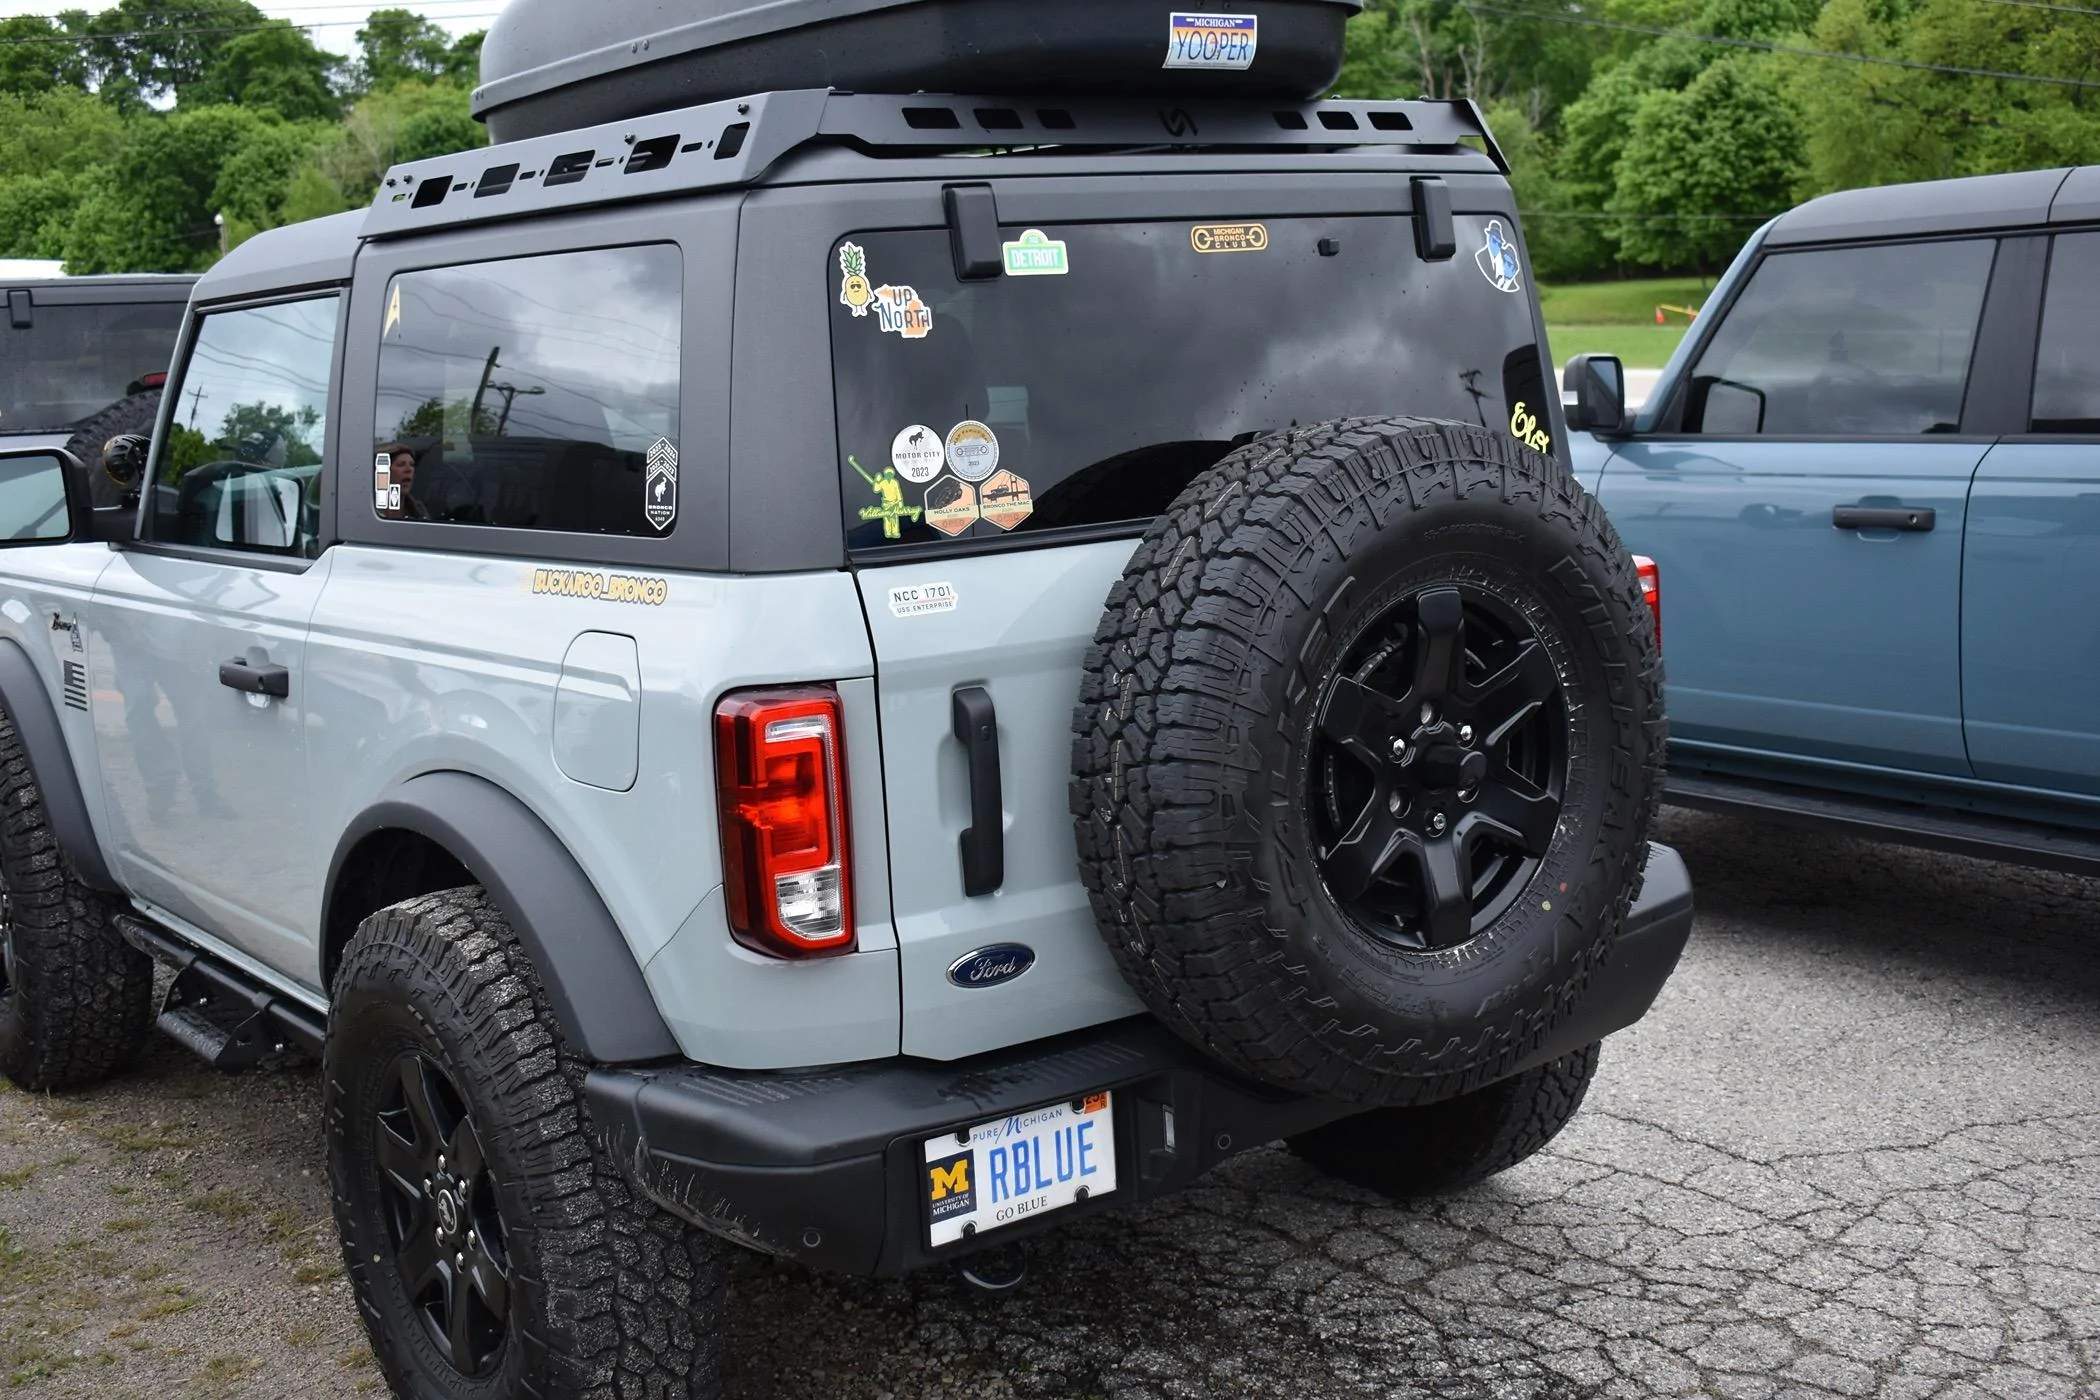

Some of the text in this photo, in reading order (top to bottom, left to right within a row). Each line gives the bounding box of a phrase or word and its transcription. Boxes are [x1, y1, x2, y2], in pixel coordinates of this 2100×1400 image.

[1194, 18, 1236, 28] MICHIGAN
[1176, 30, 1249, 61] YOOPER
[1213, 227, 1244, 235] MICHIGAN
[1214, 234, 1246, 242] BRONCO
[1010, 248, 1059, 268] DETROIT
[892, 288, 912, 307] UP
[895, 452, 922, 460] MOTOR
[911, 466, 930, 478] 2023
[893, 586, 951, 602] NCC 1701
[897, 601, 953, 614] USS ENTERPRISE
[969, 956, 1016, 981] Ford
[972, 1108, 1063, 1144] PURE MICHIGAN
[988, 1120, 1097, 1205] RBLUE
[930, 1159, 969, 1201] M
[932, 1196, 962, 1208] UNIVERSITY
[932, 1199, 970, 1216] MICHIGAN
[995, 1196, 1048, 1222] GO BLUE
